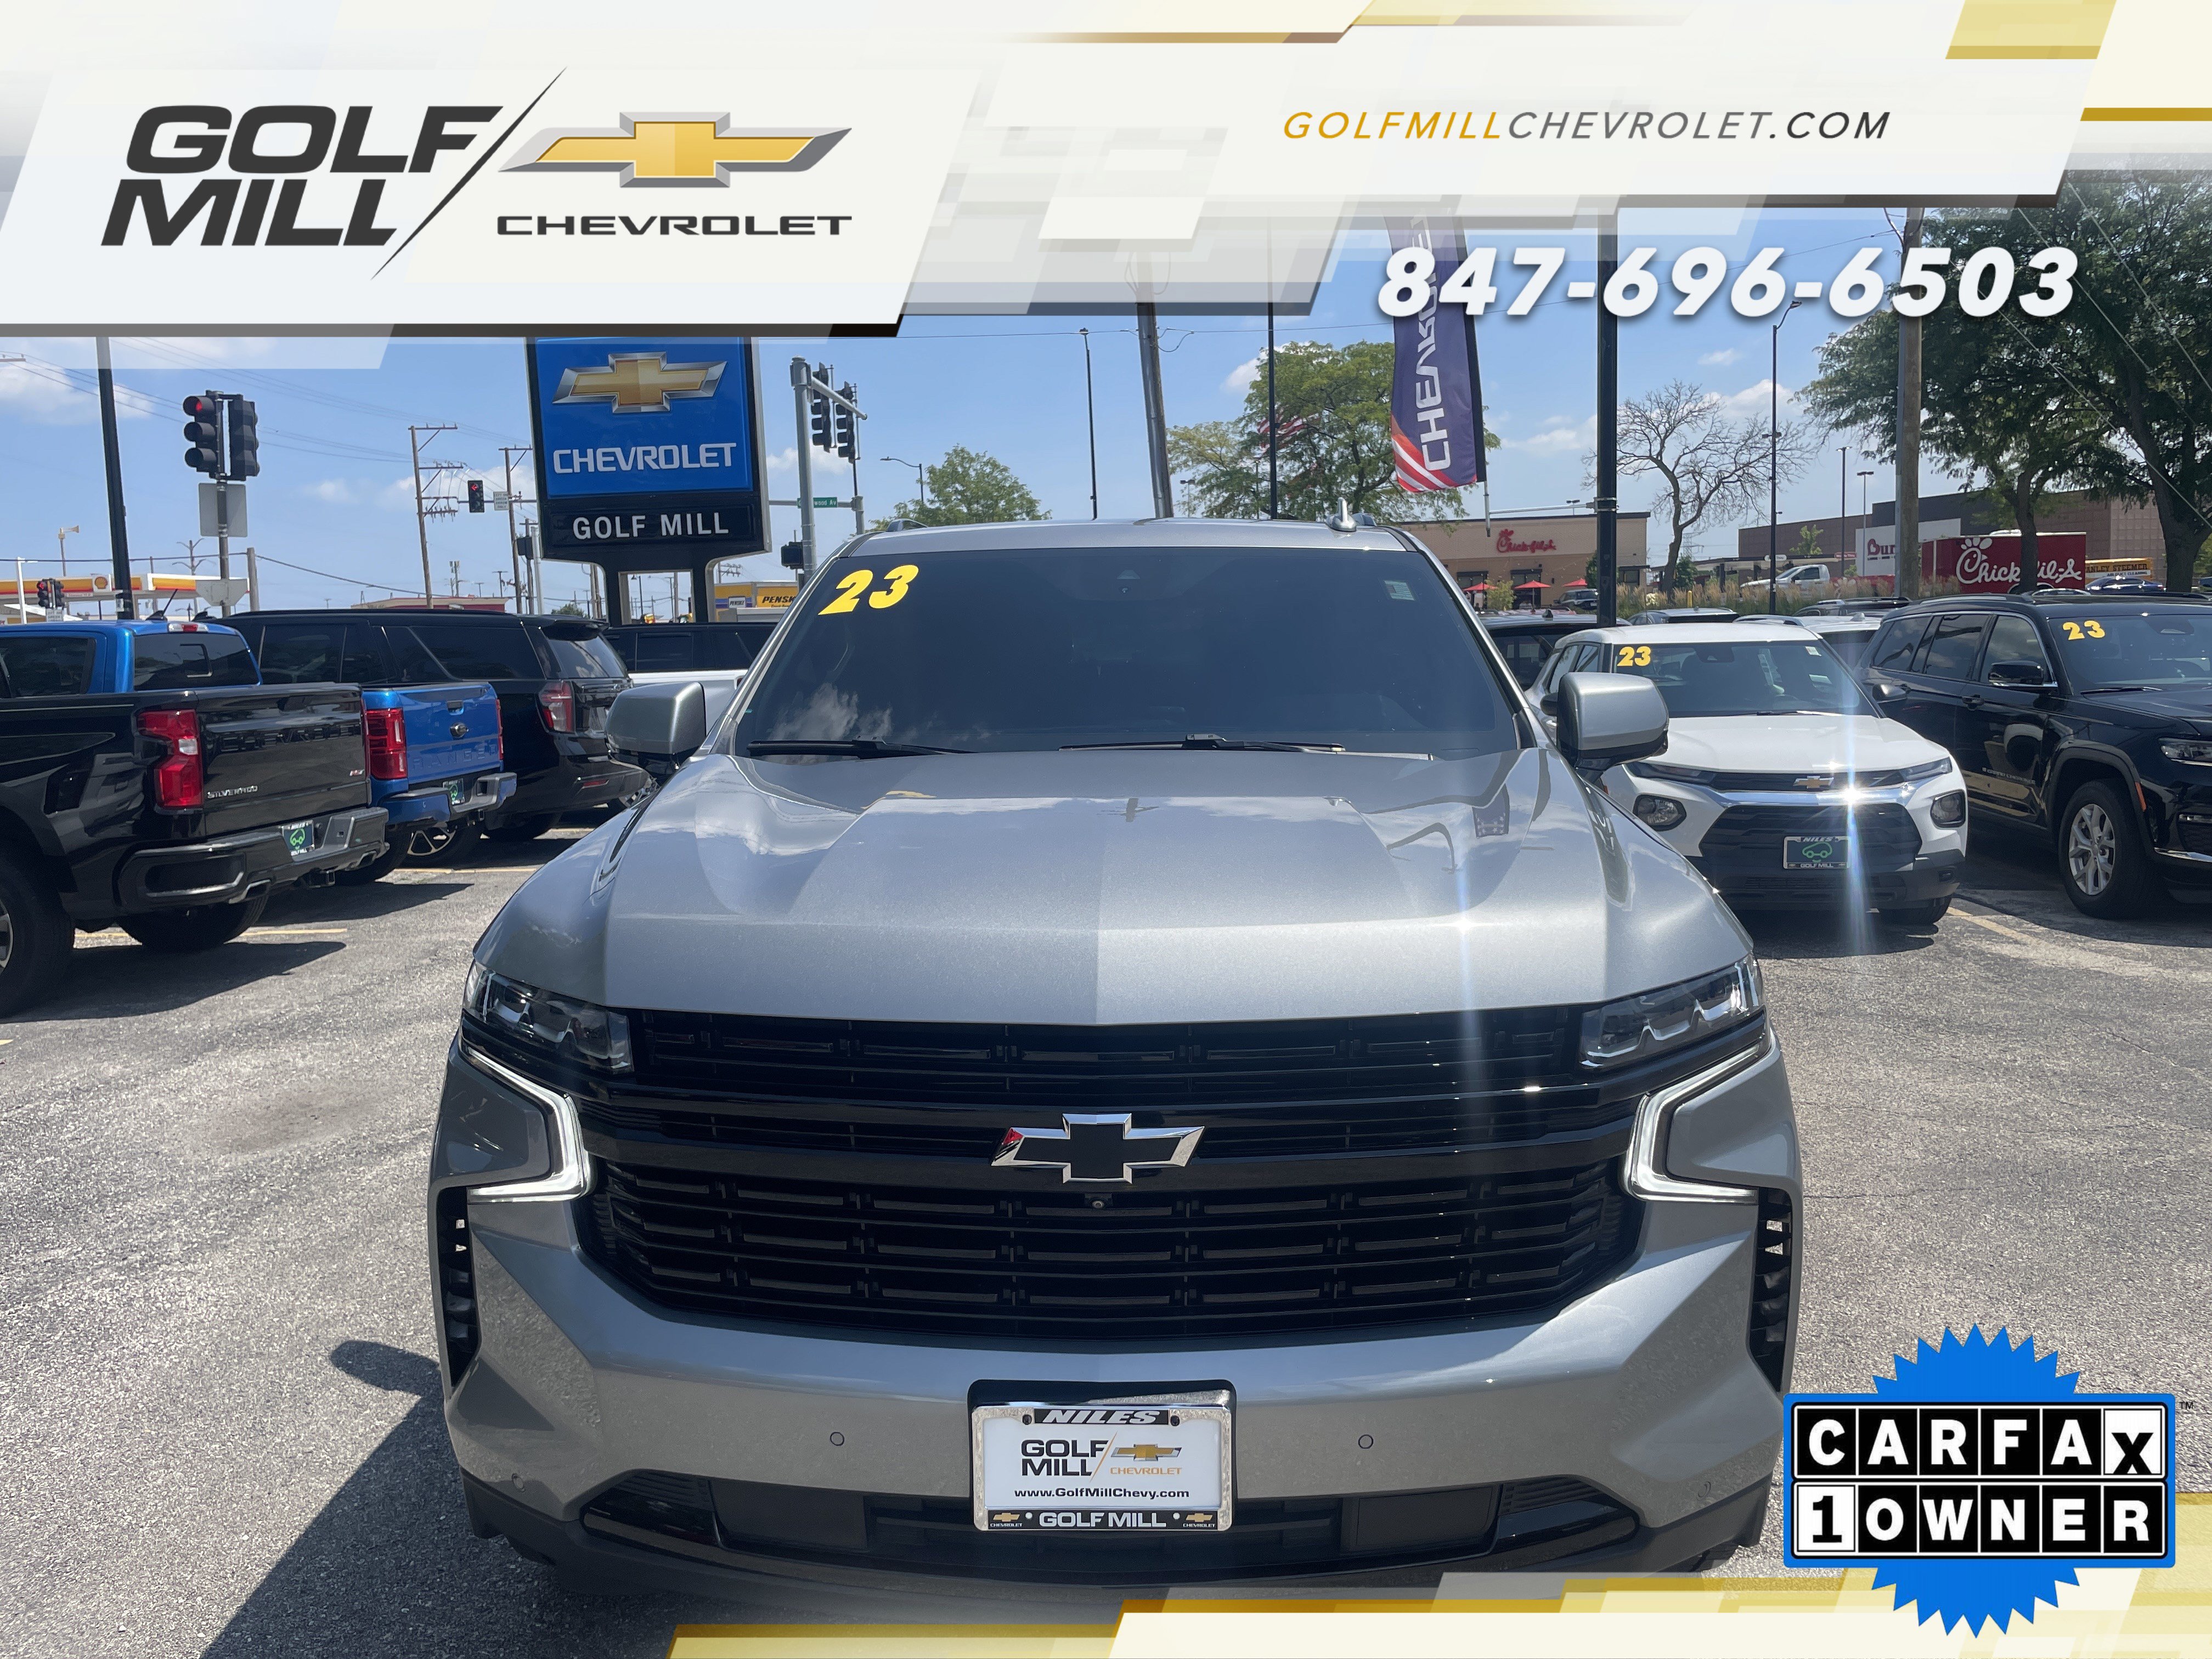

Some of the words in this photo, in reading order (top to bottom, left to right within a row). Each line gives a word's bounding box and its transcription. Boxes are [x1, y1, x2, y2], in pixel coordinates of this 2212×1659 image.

[553, 443, 736, 474] CHEVROLET
[573, 515, 646, 540] GOLF
[661, 512, 729, 537] MILL
[817, 565, 919, 615] 23
[2063, 620, 2106, 640] 23
[1617, 646, 1651, 666] 23
[208, 785, 258, 798] SILVERADO
[1042, 1409, 1160, 1424] NILES
[1021, 1440, 1109, 1457] GOLF
[1022, 1458, 1092, 1476] MILL
[1110, 1466, 1183, 1475] CHEVROLET
[1014, 1488, 1189, 1499] www.GolfMillChevy.com
[1039, 1512, 1104, 1527] GOLF
[1108, 1513, 1167, 1528] MILL
